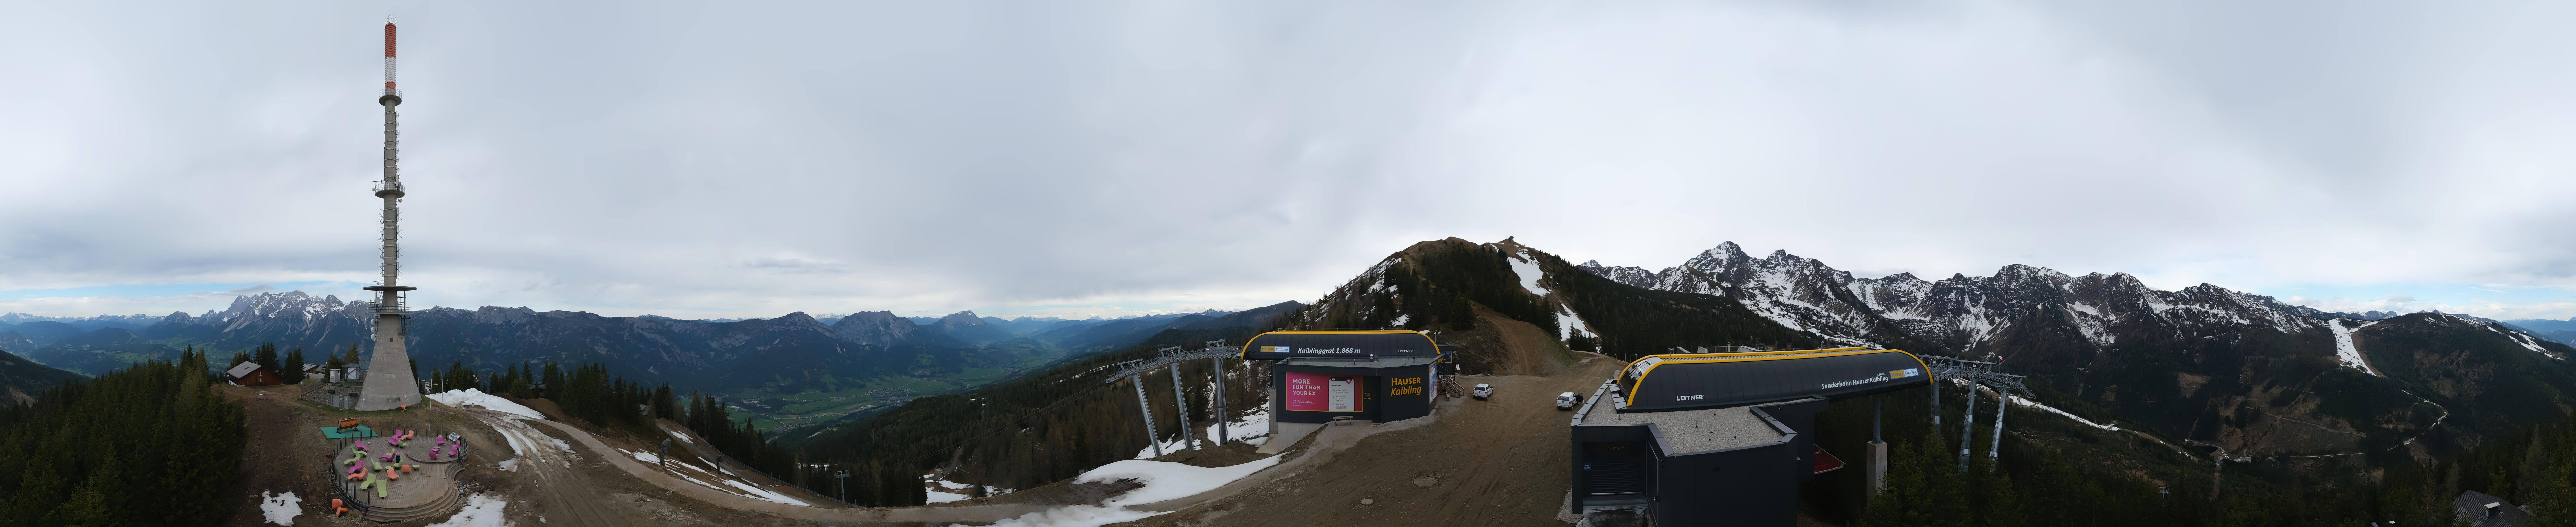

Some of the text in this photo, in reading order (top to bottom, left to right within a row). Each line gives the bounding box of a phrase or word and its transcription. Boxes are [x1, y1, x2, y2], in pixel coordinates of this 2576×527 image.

[1391, 377, 1421, 386] HAUSER
[1821, 380, 1852, 389] Senderbahn
[1391, 386, 1421, 396] Kaibling
